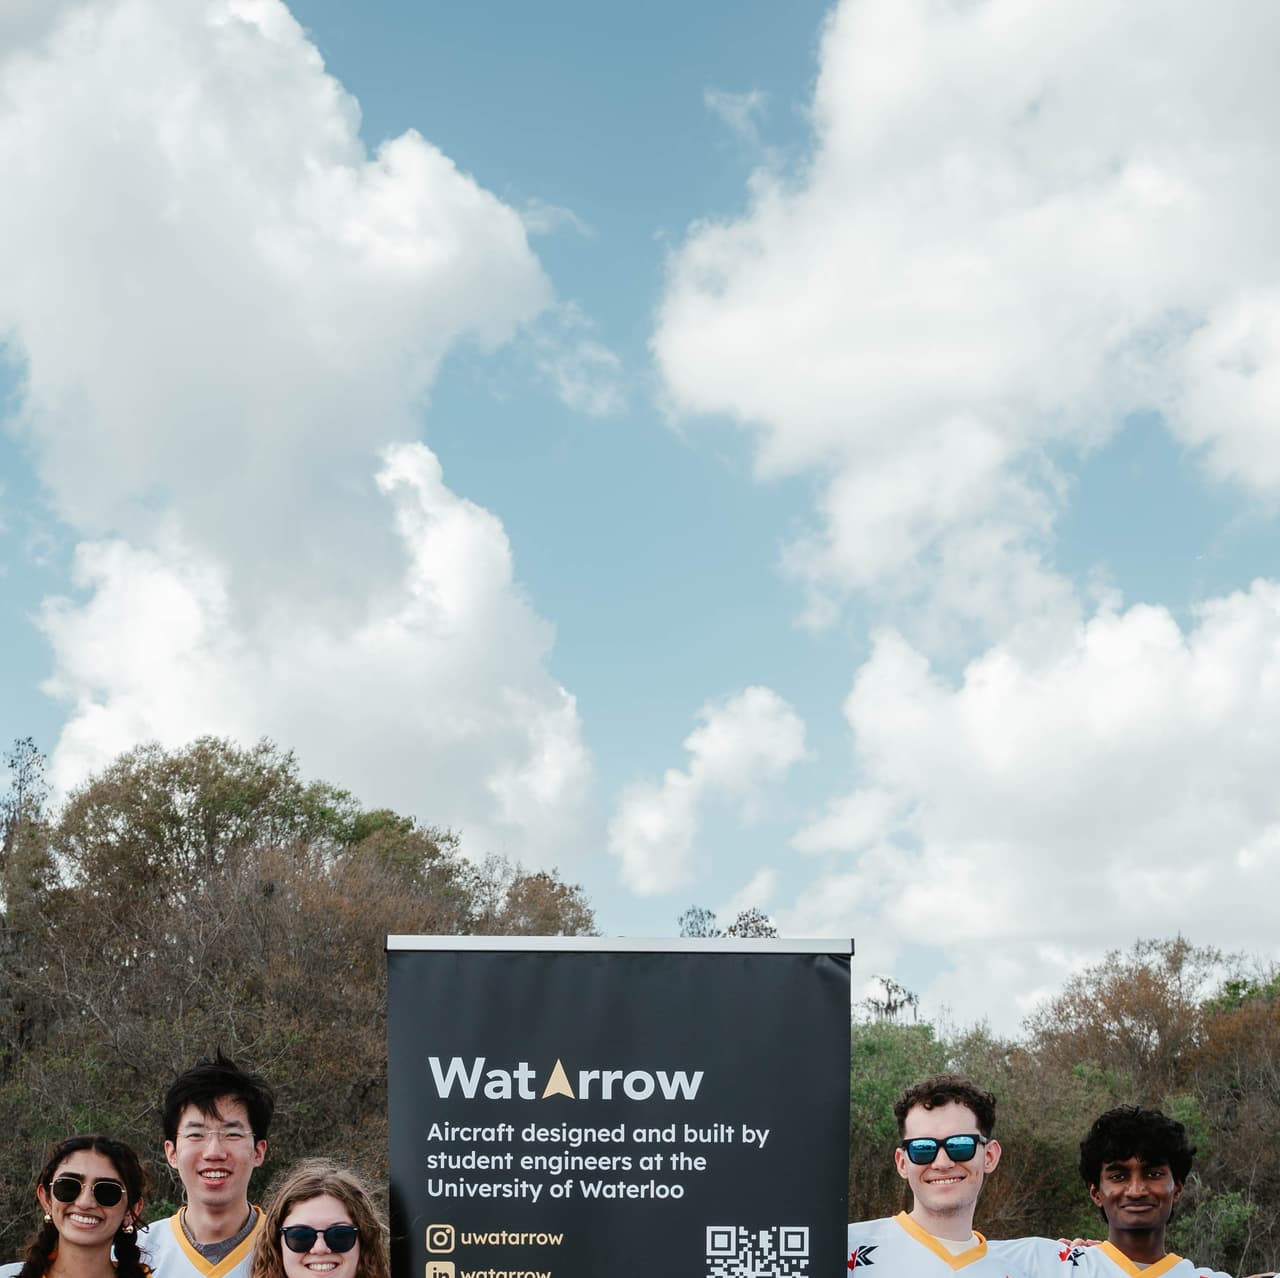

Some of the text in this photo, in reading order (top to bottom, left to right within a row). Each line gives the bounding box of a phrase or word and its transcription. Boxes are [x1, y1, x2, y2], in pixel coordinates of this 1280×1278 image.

[427, 1122, 769, 1148] Aircraft designed and built by
[427, 1151, 707, 1175] student engineers at the
[427, 1178, 684, 1203] University of Waterloo
[461, 1230, 563, 1245] uwatarrow
